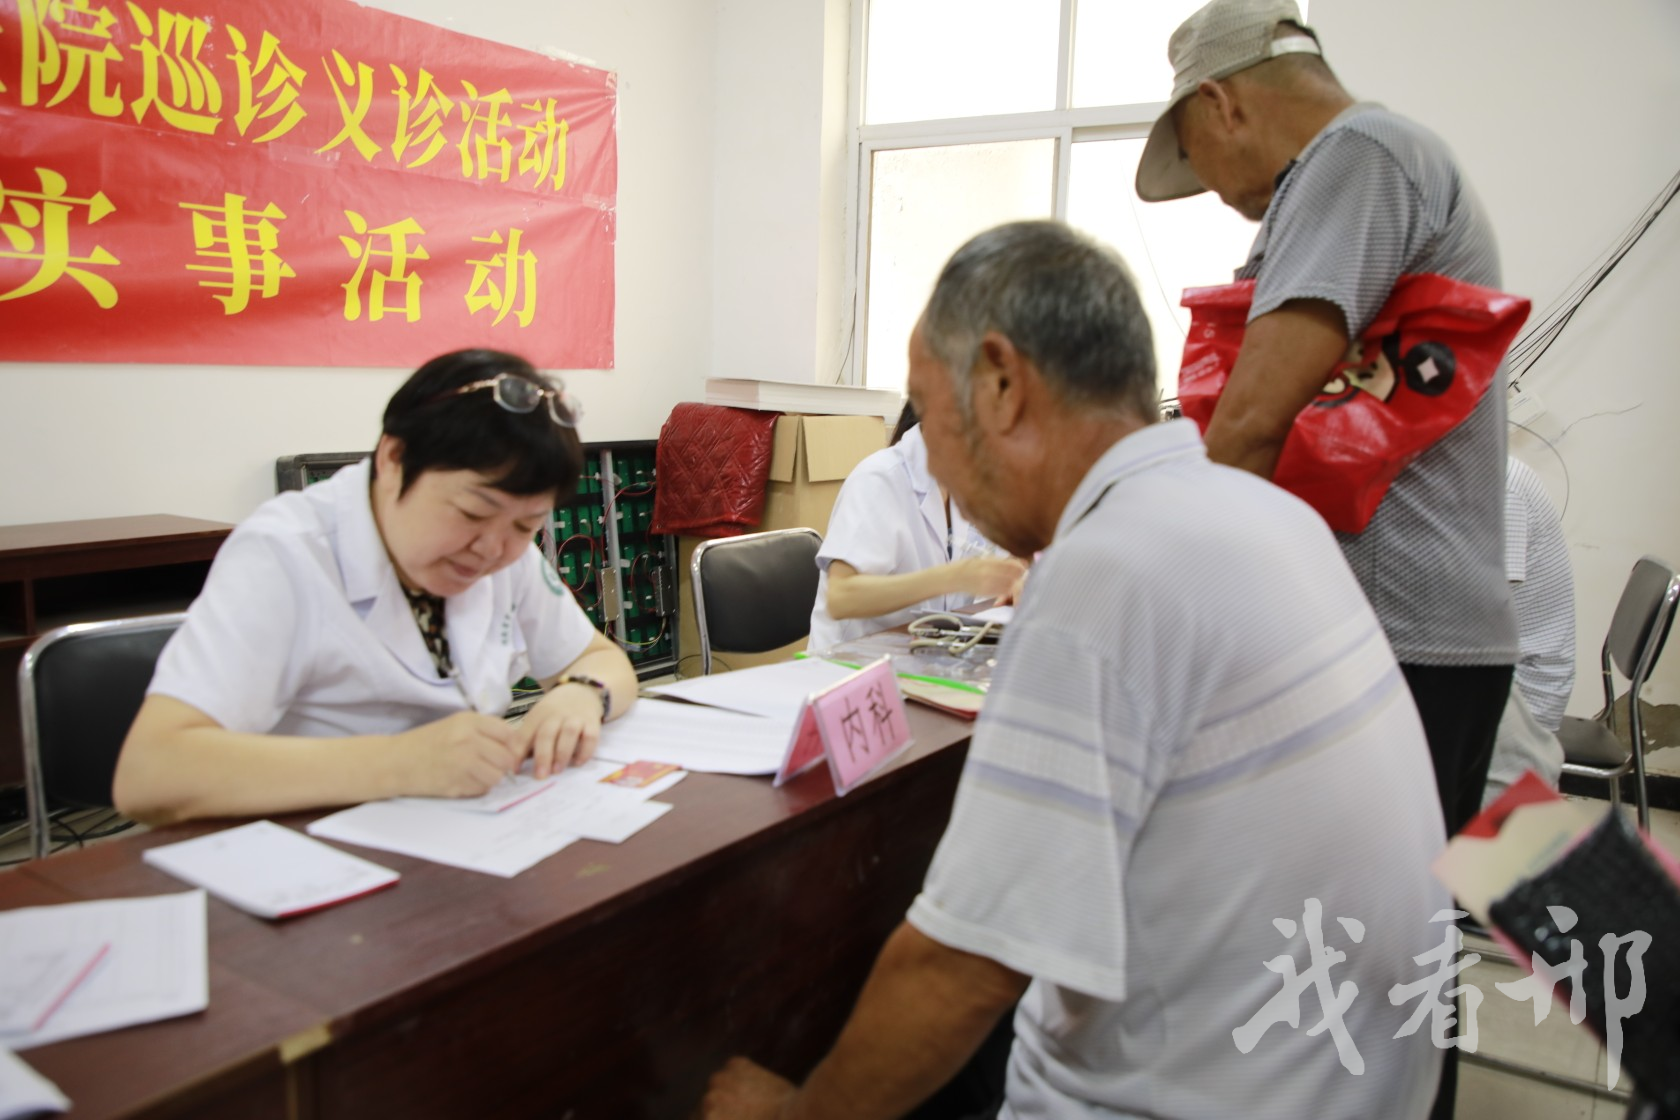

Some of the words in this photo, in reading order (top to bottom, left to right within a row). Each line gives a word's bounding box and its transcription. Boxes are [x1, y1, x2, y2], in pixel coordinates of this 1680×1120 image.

[0, 0, 568, 191] 院巡诊义诊活动
[0, 167, 538, 328] 实事活动
[840, 681, 896, 763] 内科
